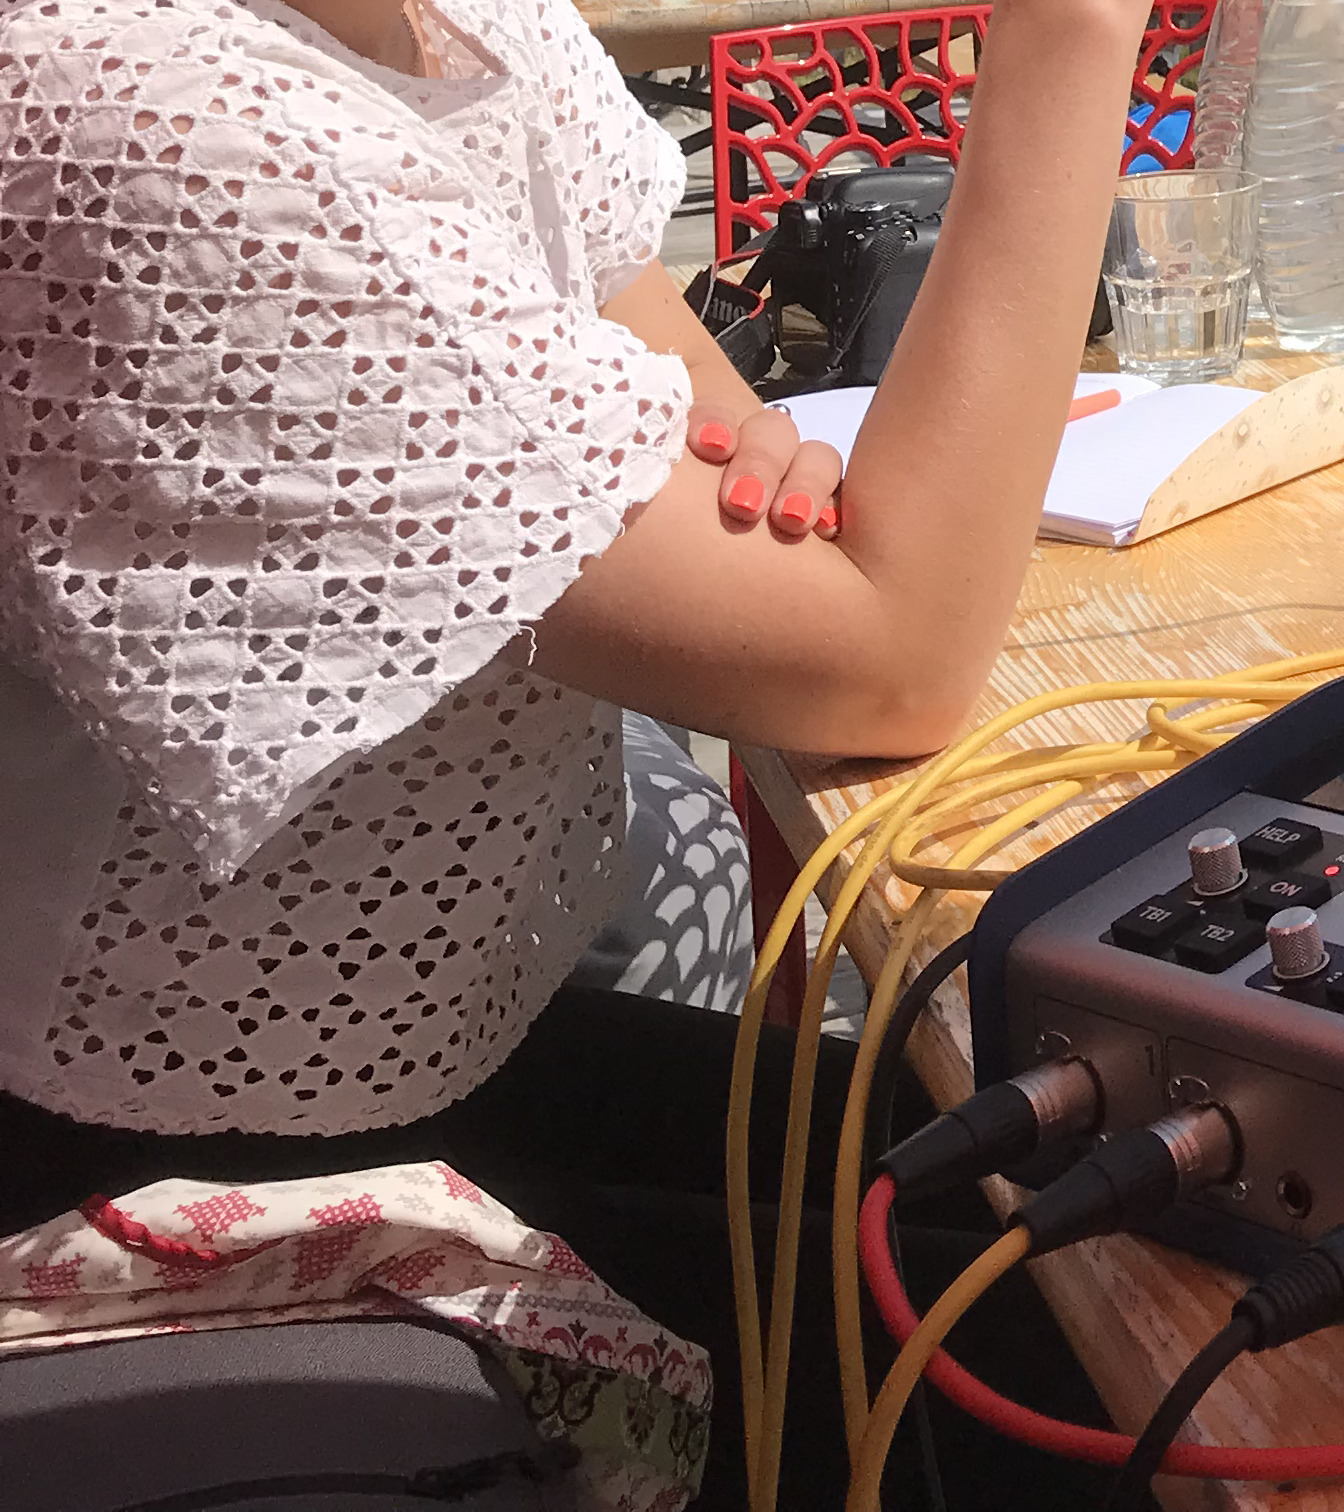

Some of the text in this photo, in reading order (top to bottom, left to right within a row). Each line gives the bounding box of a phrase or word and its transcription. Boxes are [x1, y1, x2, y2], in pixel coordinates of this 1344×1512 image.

[1255, 826, 1301, 844] HELP
[1269, 881, 1302, 897] ON
[1139, 905, 1173, 923] TB1
[1200, 924, 1235, 942] TB2
